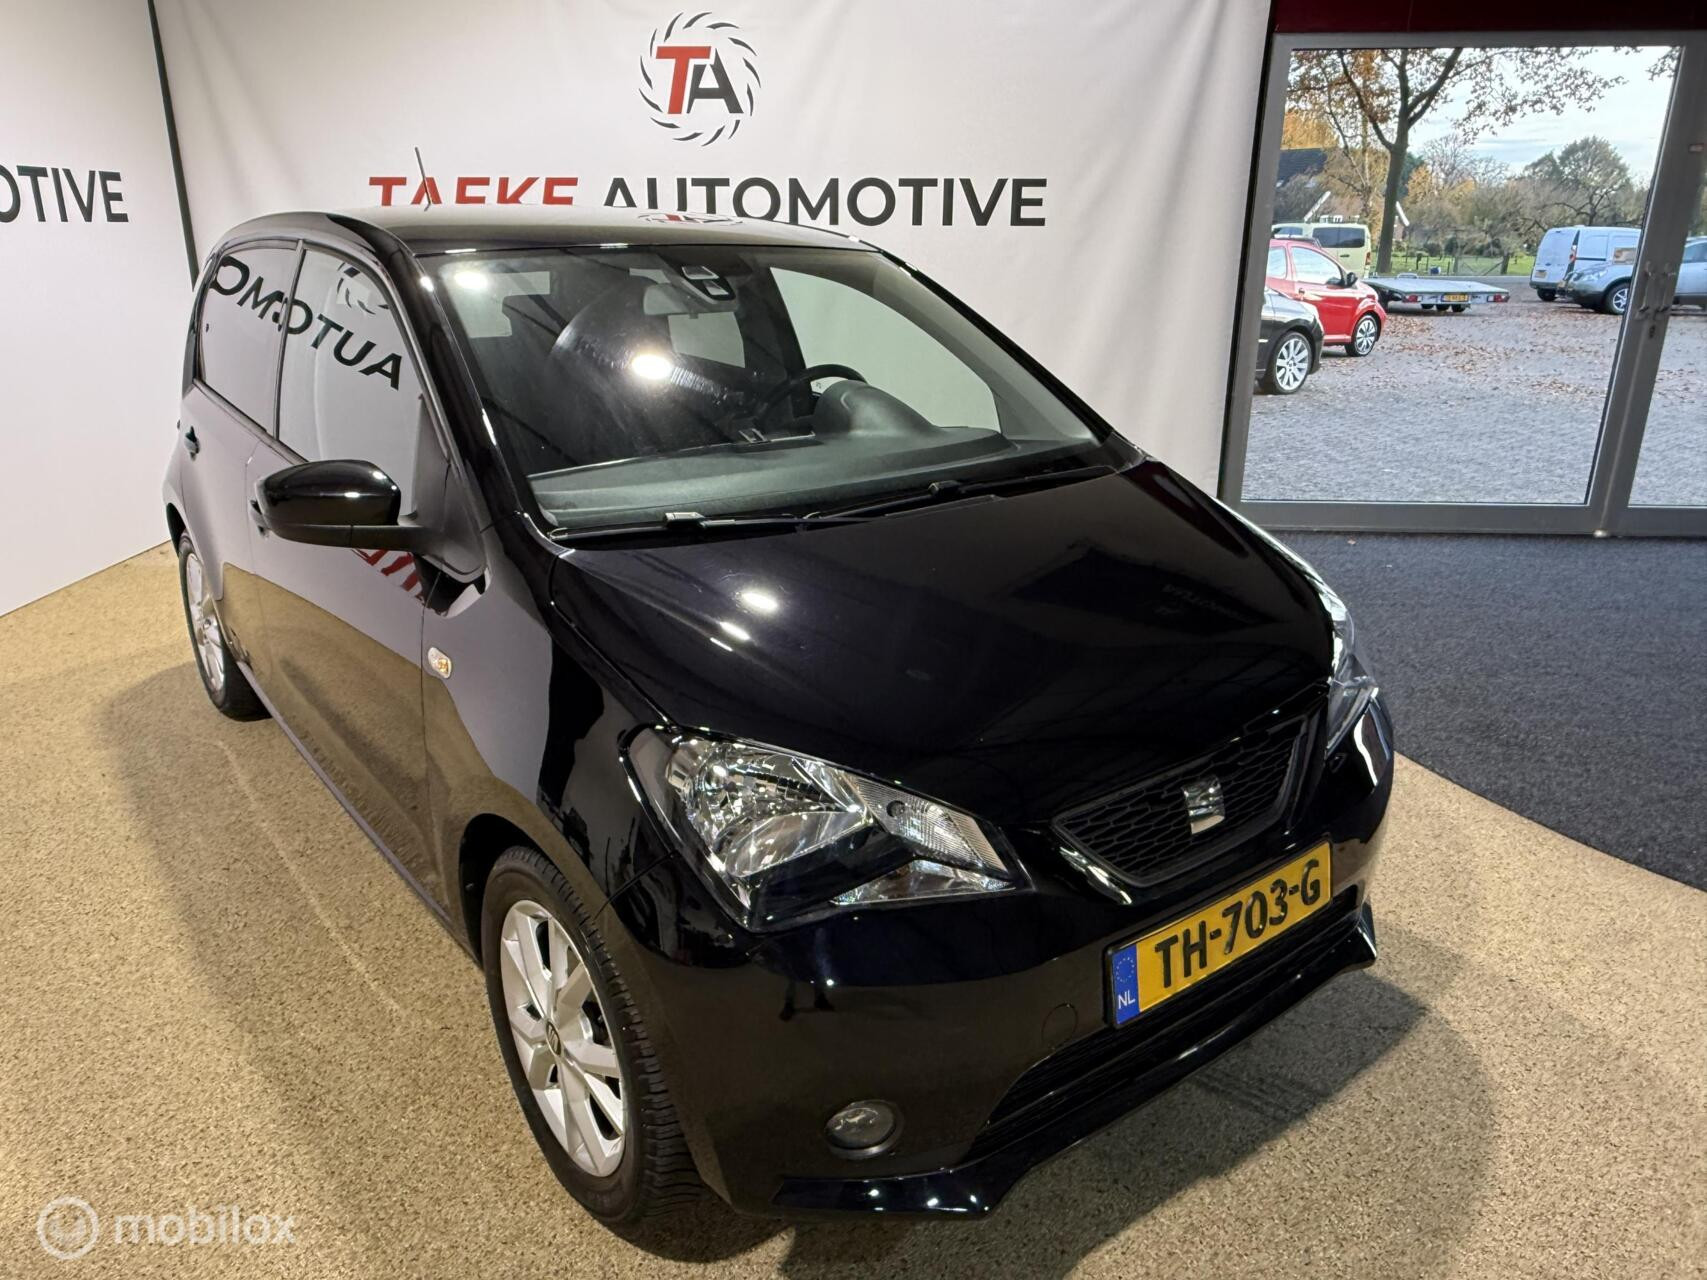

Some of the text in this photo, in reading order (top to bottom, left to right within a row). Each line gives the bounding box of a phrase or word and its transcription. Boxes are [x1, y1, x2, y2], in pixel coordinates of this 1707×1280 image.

[656, 46, 743, 115] TA
[604, 177, 1047, 226] AUTOMOTIVE
[1155, 859, 1321, 988] TH-703-G
[1118, 989, 1136, 1009] NL
